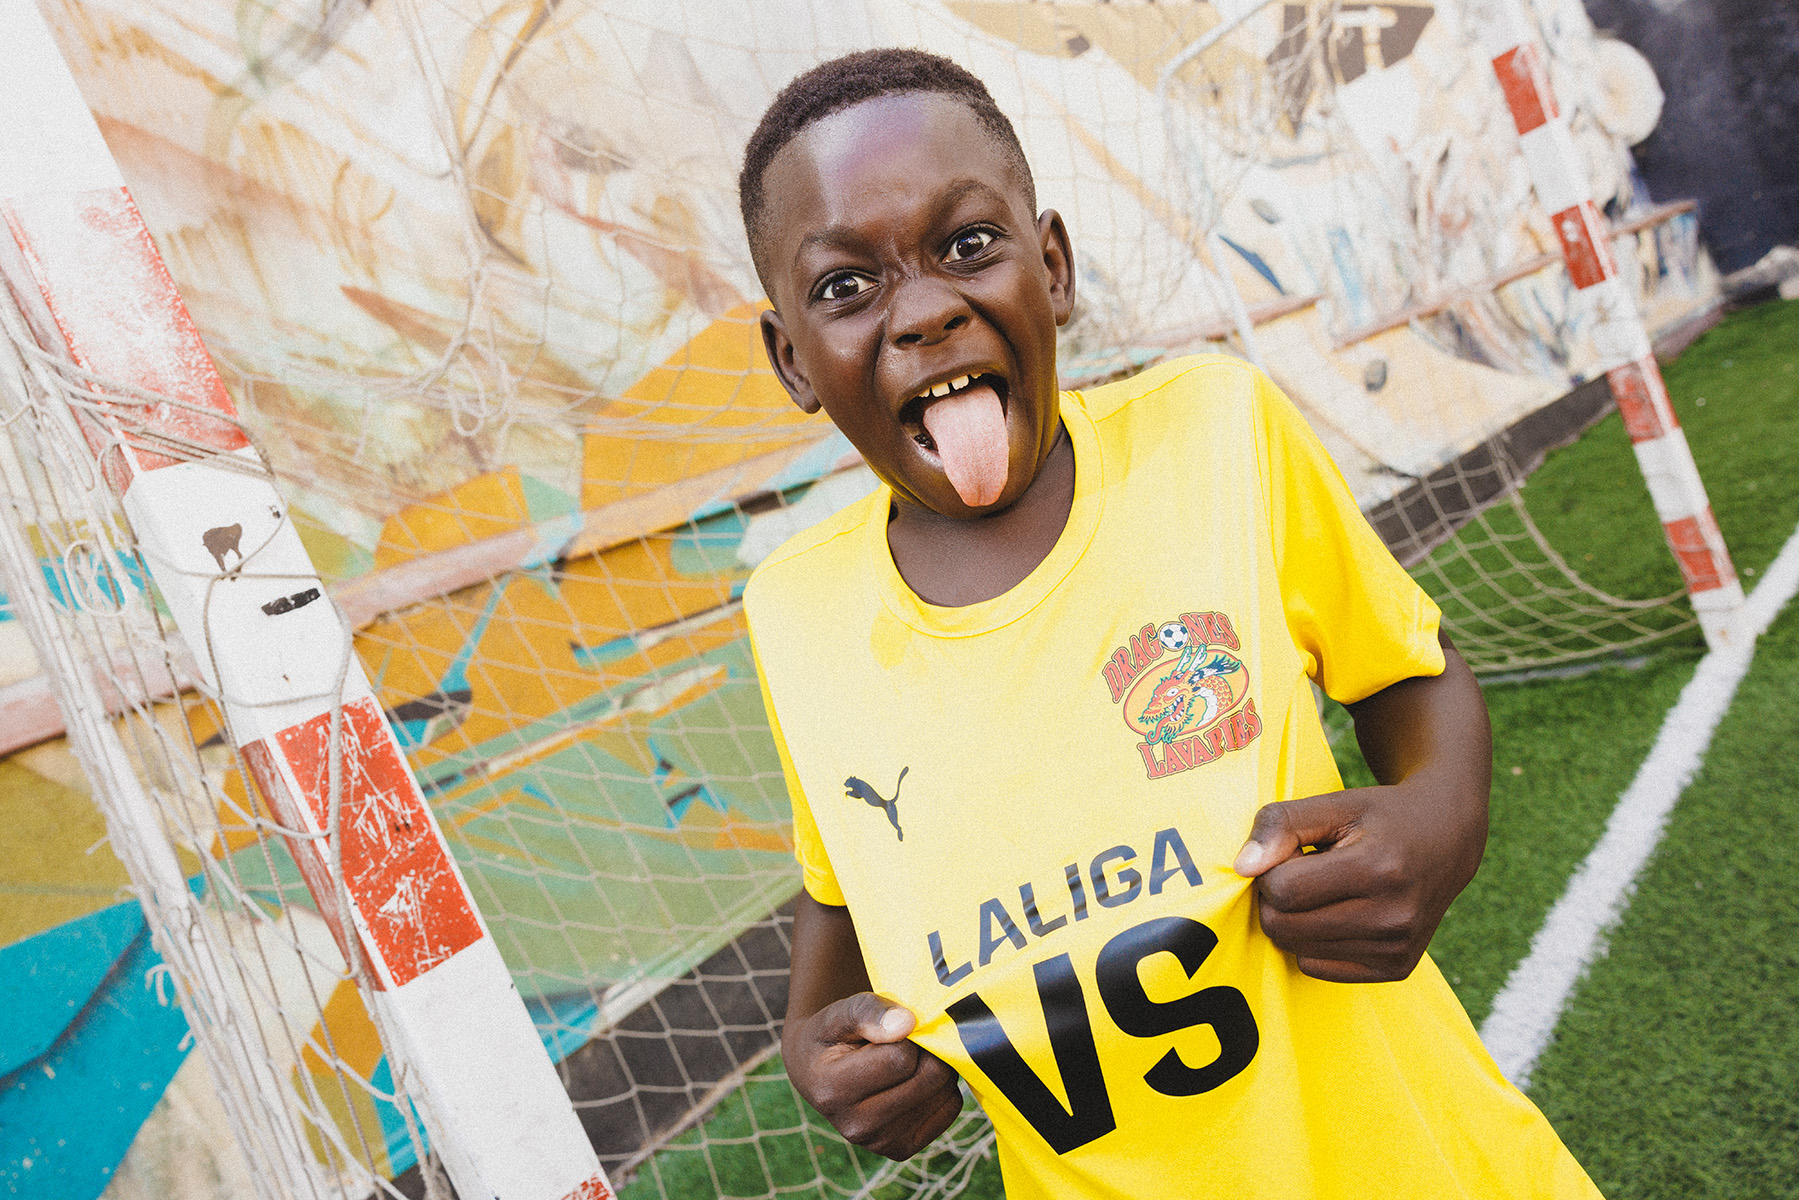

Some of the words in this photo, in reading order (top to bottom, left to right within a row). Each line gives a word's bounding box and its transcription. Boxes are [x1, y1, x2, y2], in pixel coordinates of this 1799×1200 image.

[1137, 698, 1263, 780] LAVAPIES
[927, 827, 1204, 987] LALIGA
[944, 916, 1260, 1156] VS
